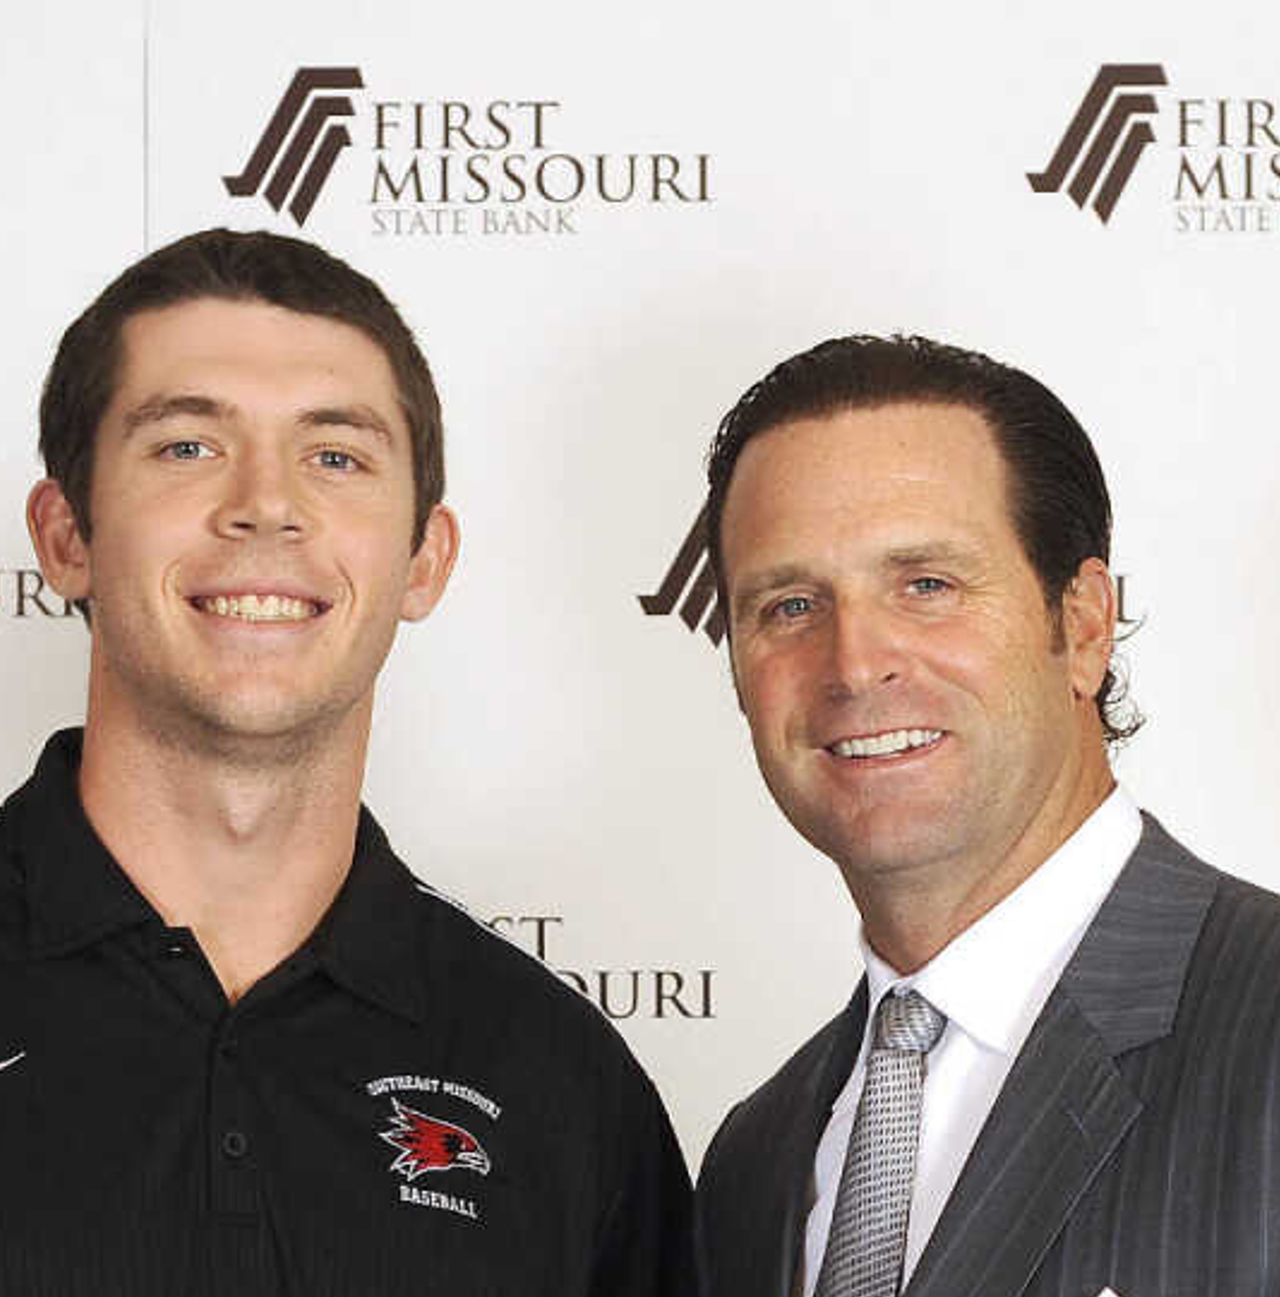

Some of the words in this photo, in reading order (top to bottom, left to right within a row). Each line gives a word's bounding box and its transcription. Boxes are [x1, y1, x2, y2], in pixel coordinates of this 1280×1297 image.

[372, 100, 560, 152] FIRST
[369, 153, 710, 205] MISSOURI
[370, 209, 468, 236] STATE
[482, 209, 578, 236] BANK
[1175, 206, 1273, 233] STATE
[399, 1184, 478, 1220] BASEBALL
